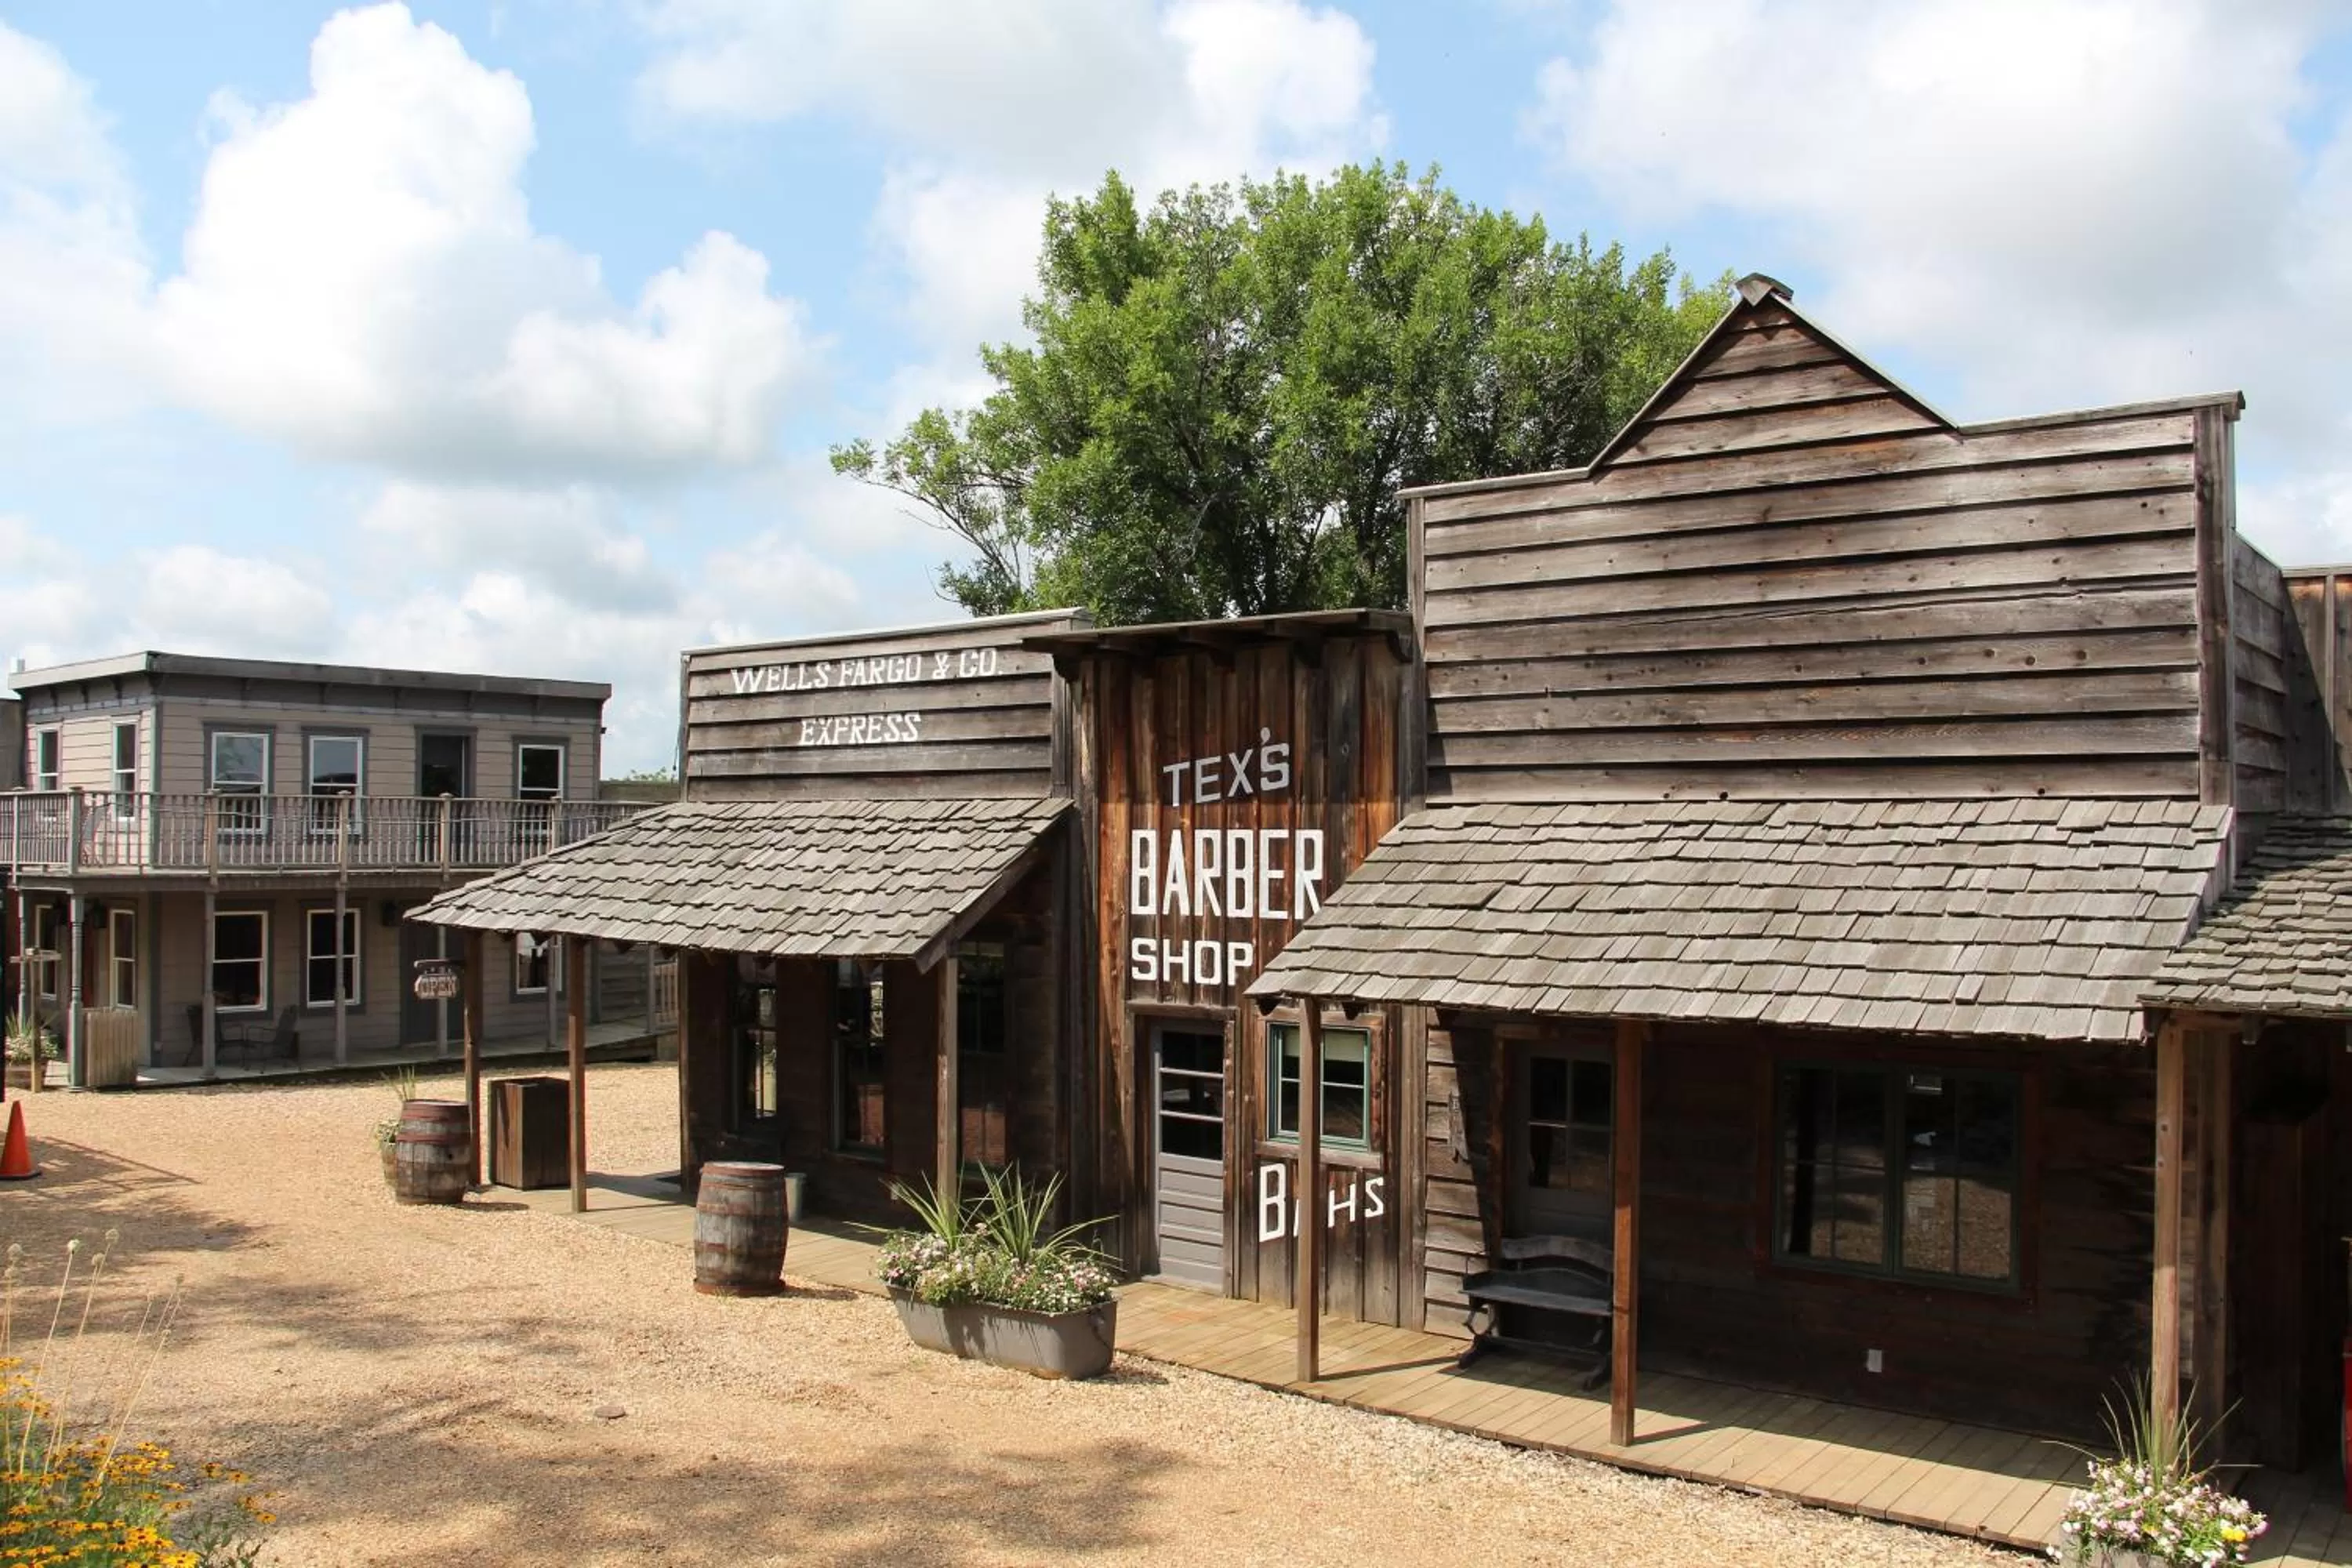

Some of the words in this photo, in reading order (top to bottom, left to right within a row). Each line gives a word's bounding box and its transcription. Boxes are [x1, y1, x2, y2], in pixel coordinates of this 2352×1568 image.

[731, 660, 833, 694] WELLS
[838, 653, 922, 688] FARGO
[932, 650, 951, 680] &
[958, 647, 1004, 678] CO.
[798, 711, 922, 746] EXPRESS
[1163, 726, 1290, 807] TEX'S
[1131, 829, 1324, 920] BARBER
[1131, 938, 1254, 985] SHOP
[420, 976, 457, 998] OPEN
[1259, 1163, 1384, 1243] BHS
